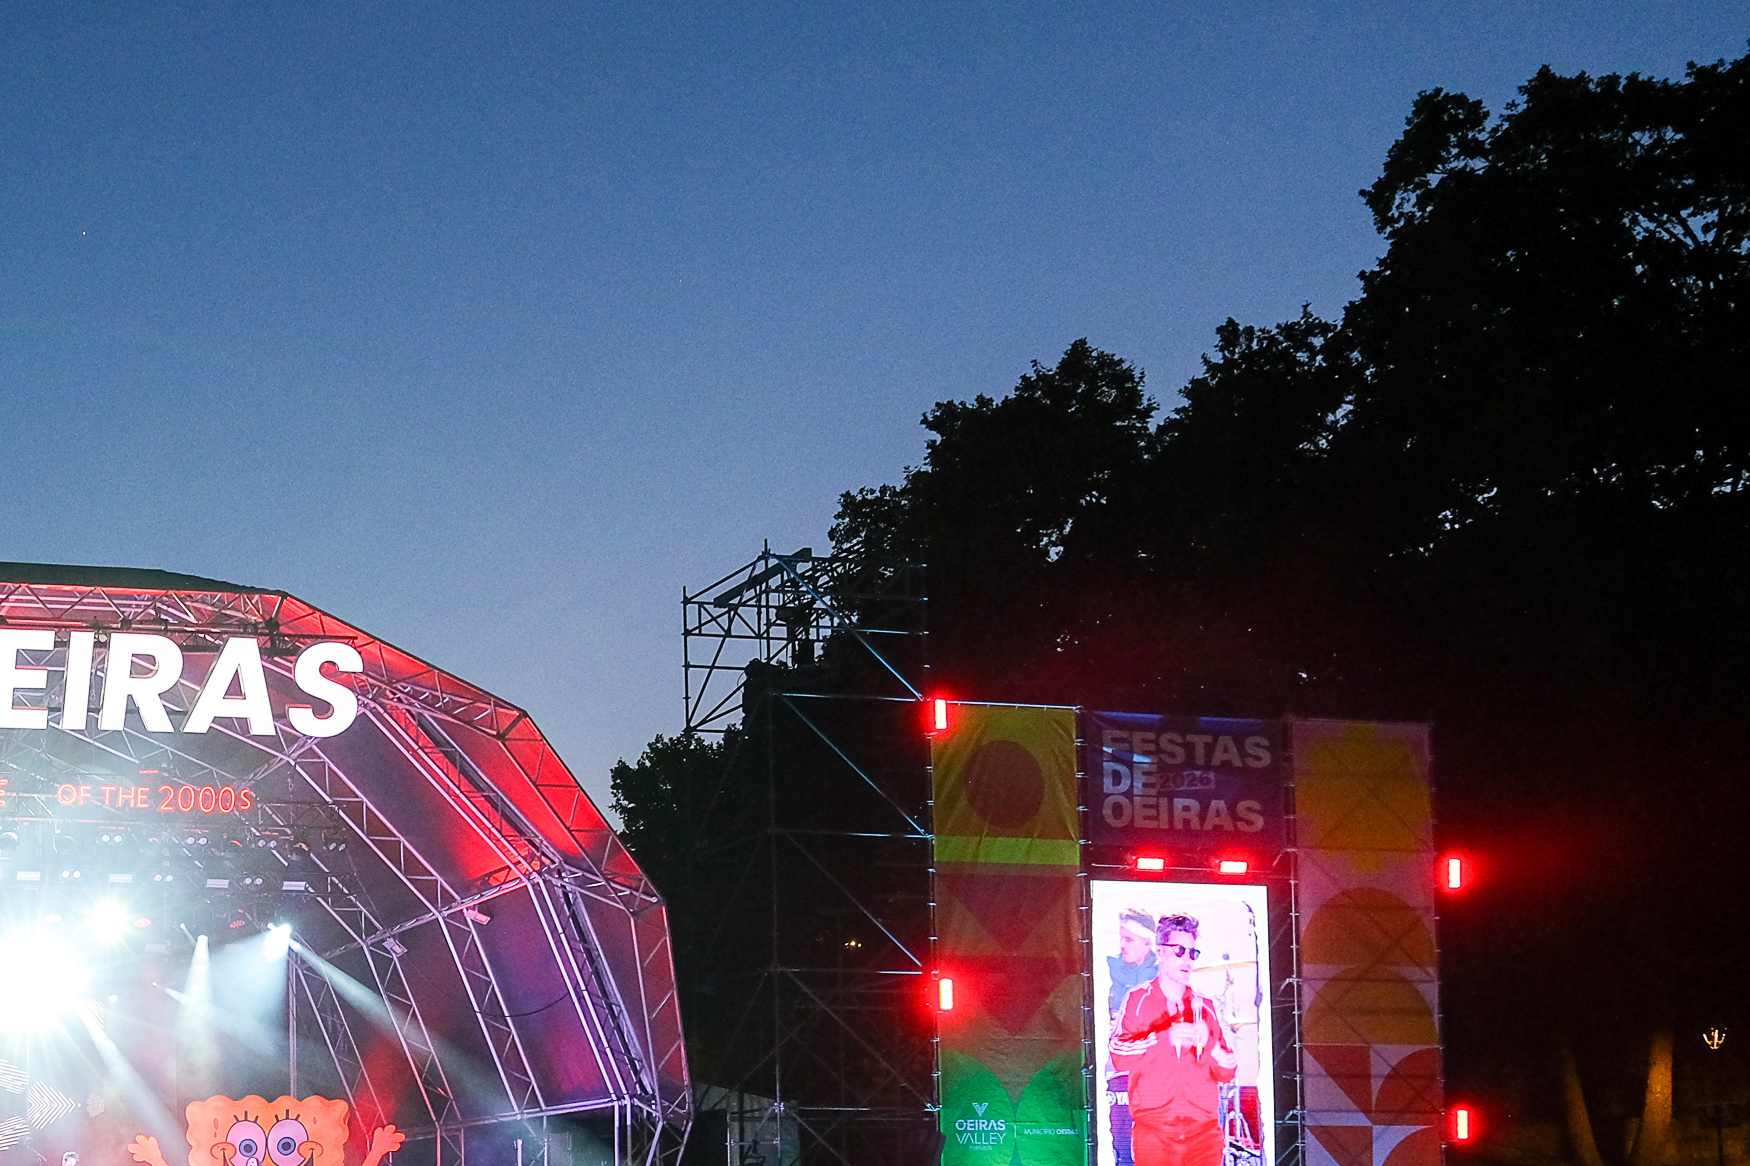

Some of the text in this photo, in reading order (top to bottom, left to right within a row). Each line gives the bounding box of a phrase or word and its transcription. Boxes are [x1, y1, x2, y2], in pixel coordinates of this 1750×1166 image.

[1102, 730, 1272, 768] FESTAS
[1103, 762, 1158, 796] DE
[57, 783, 92, 805] OF
[100, 786, 150, 808] THE
[1103, 794, 1264, 832] OEIRAS
[955, 1119, 1006, 1131] OEIRAS
[955, 1132, 1006, 1144] VALLEY
